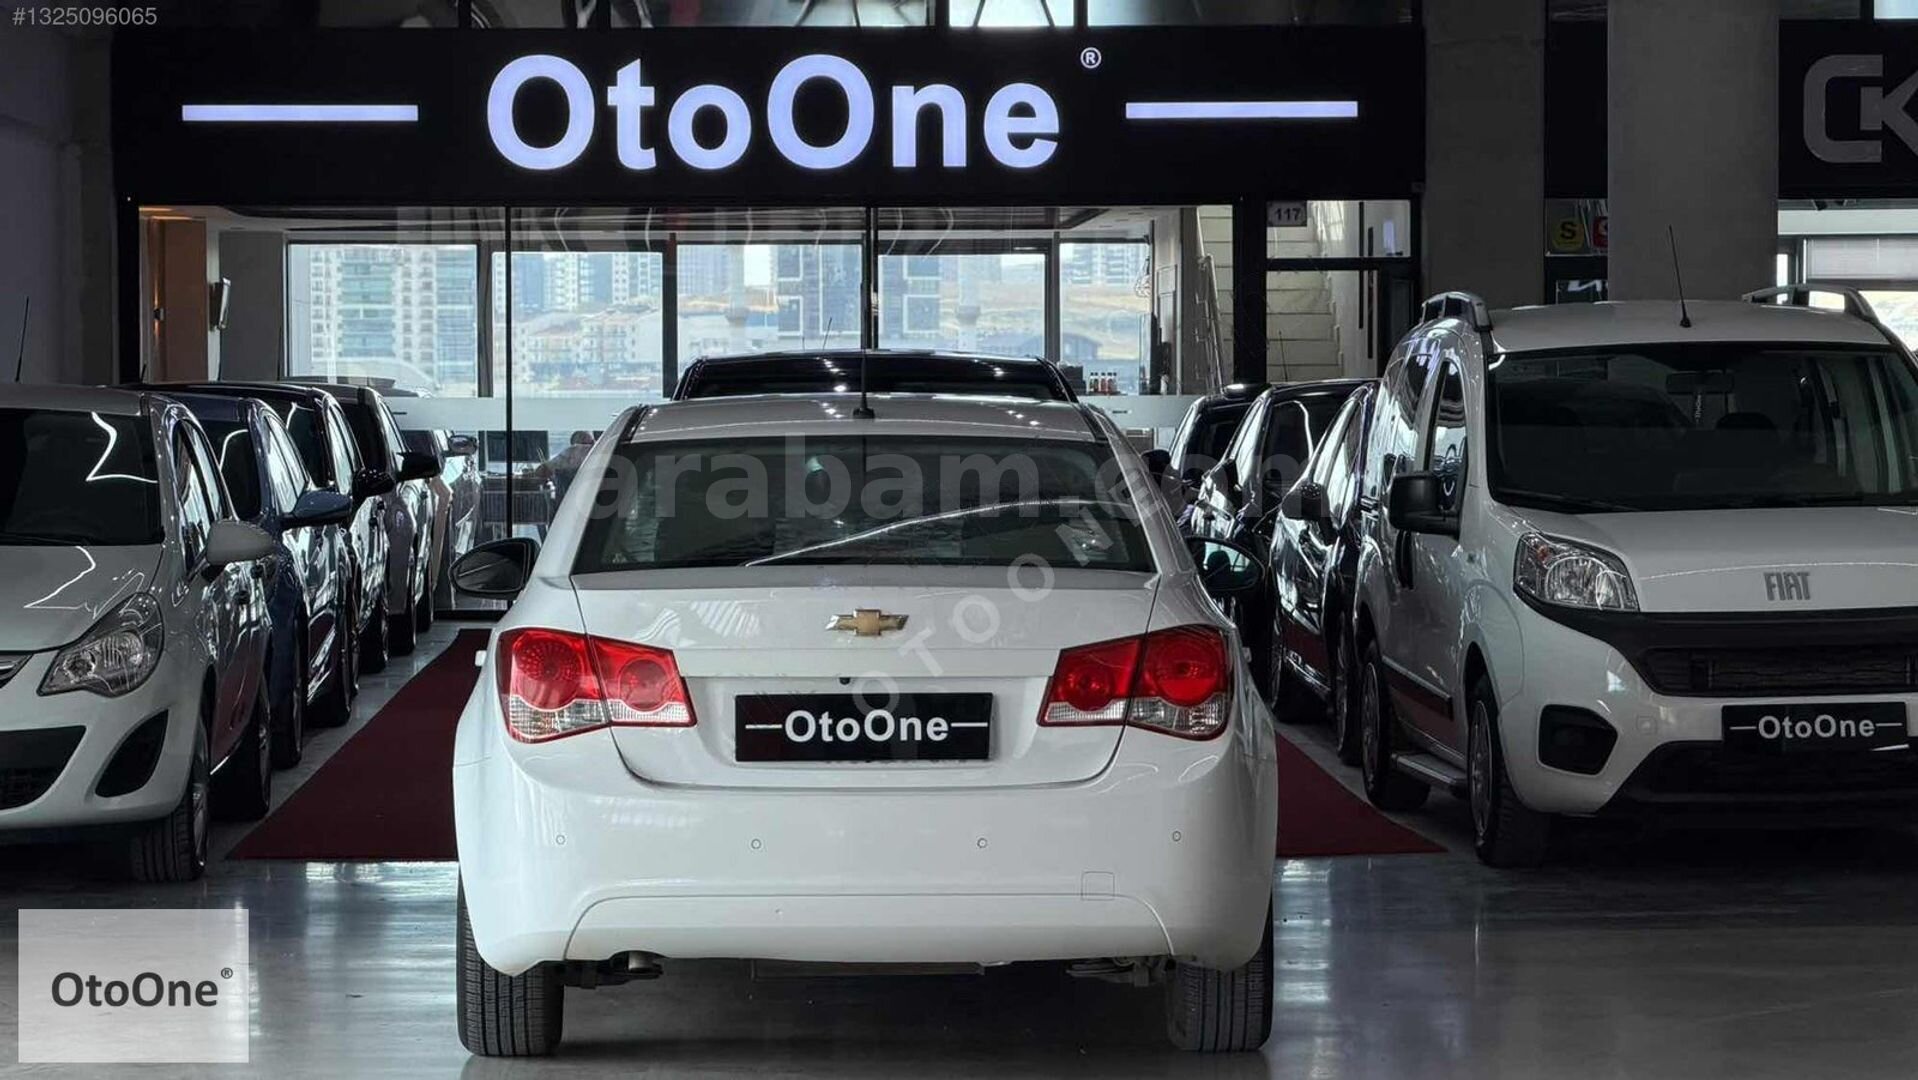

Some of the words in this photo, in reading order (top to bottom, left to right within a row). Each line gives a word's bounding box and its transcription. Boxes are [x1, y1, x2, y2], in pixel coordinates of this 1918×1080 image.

[487, 53, 1060, 171] OtoOne
[1274, 207, 1301, 221] 117
[1560, 220, 1577, 240] S
[1764, 571, 1811, 601] FIAT
[785, 709, 949, 742] OtoOne
[1758, 714, 1875, 739] OtoOne
